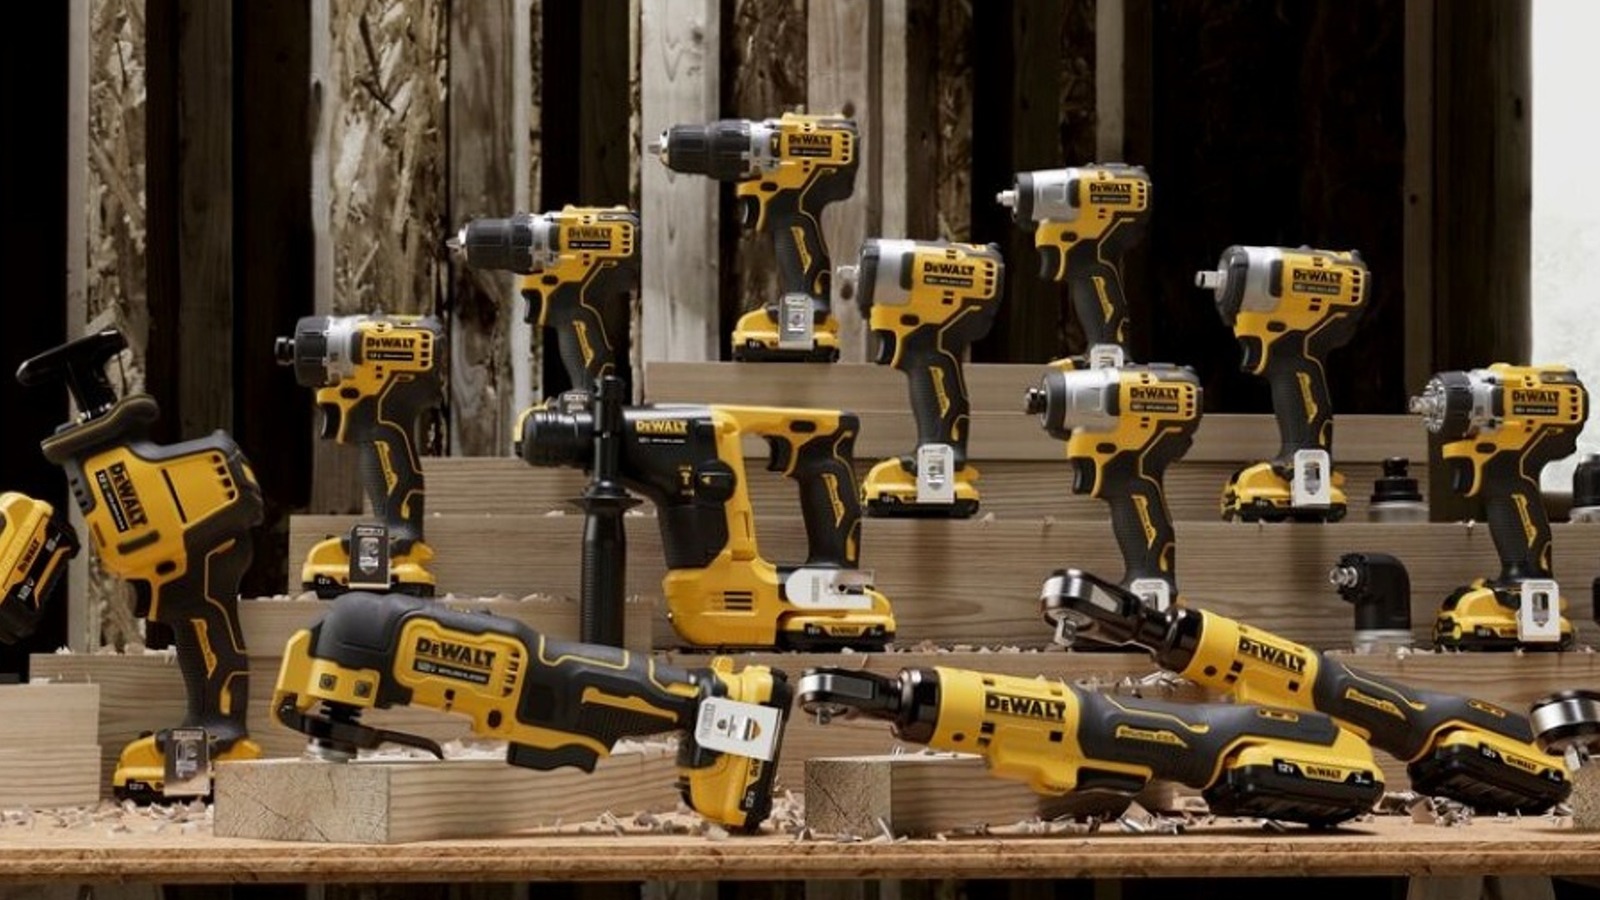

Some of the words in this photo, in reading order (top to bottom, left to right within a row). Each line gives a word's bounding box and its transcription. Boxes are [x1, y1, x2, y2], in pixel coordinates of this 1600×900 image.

[1089, 183, 1132, 193] DEWALT
[924, 262, 975, 274] DEWALT
[1293, 268, 1344, 284] DEWALT
[367, 338, 415, 348] DEWALT
[1130, 387, 1180, 399] DEWALT
[636, 420, 687, 434] DEWALT
[109, 461, 148, 527] DEWALT
[416, 637, 496, 668] DEWALT
[1239, 636, 1308, 673] DEWALT
[985, 690, 1067, 719] DEWALT
[1306, 765, 1341, 779] DEWALT
